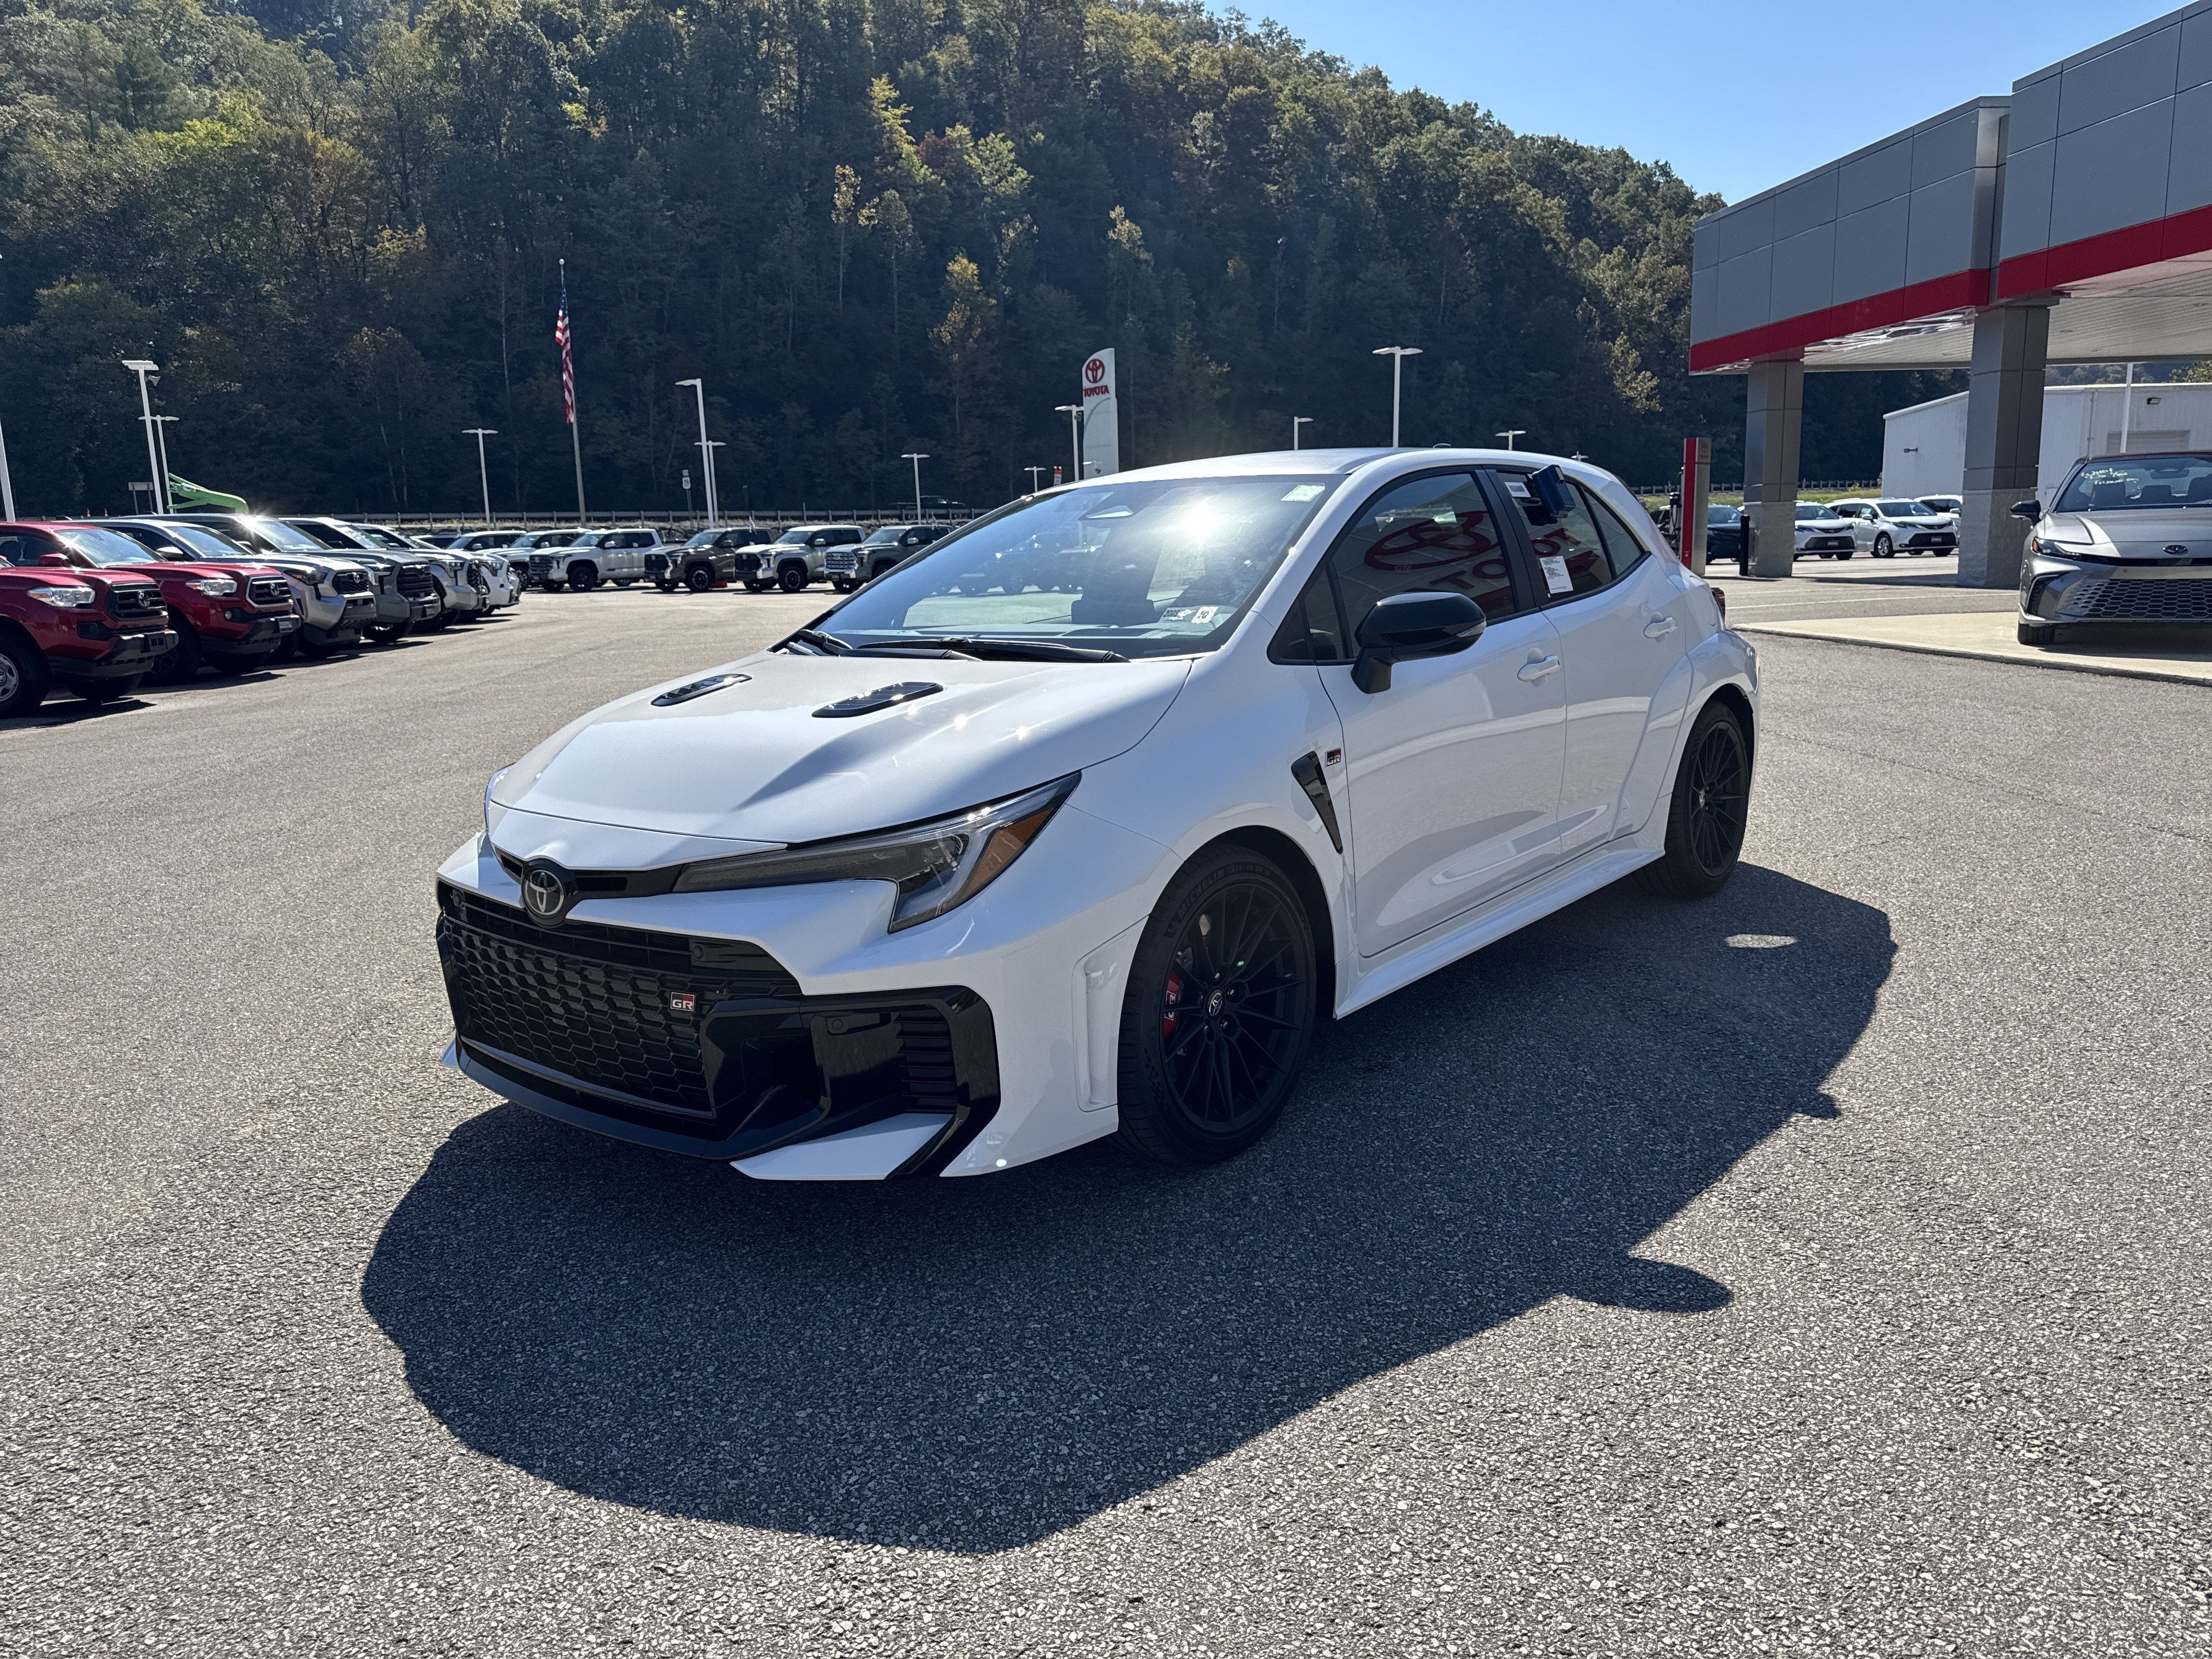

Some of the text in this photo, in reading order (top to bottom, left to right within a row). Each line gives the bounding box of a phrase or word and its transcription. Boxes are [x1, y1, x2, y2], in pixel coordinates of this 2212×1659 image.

[1084, 385, 1109, 397] TOYOTA
[1198, 610, 1209, 619] 10
[1328, 754, 1340, 765] GR
[1177, 868, 1224, 920] MICHELIN
[672, 999, 693, 1010] GR
